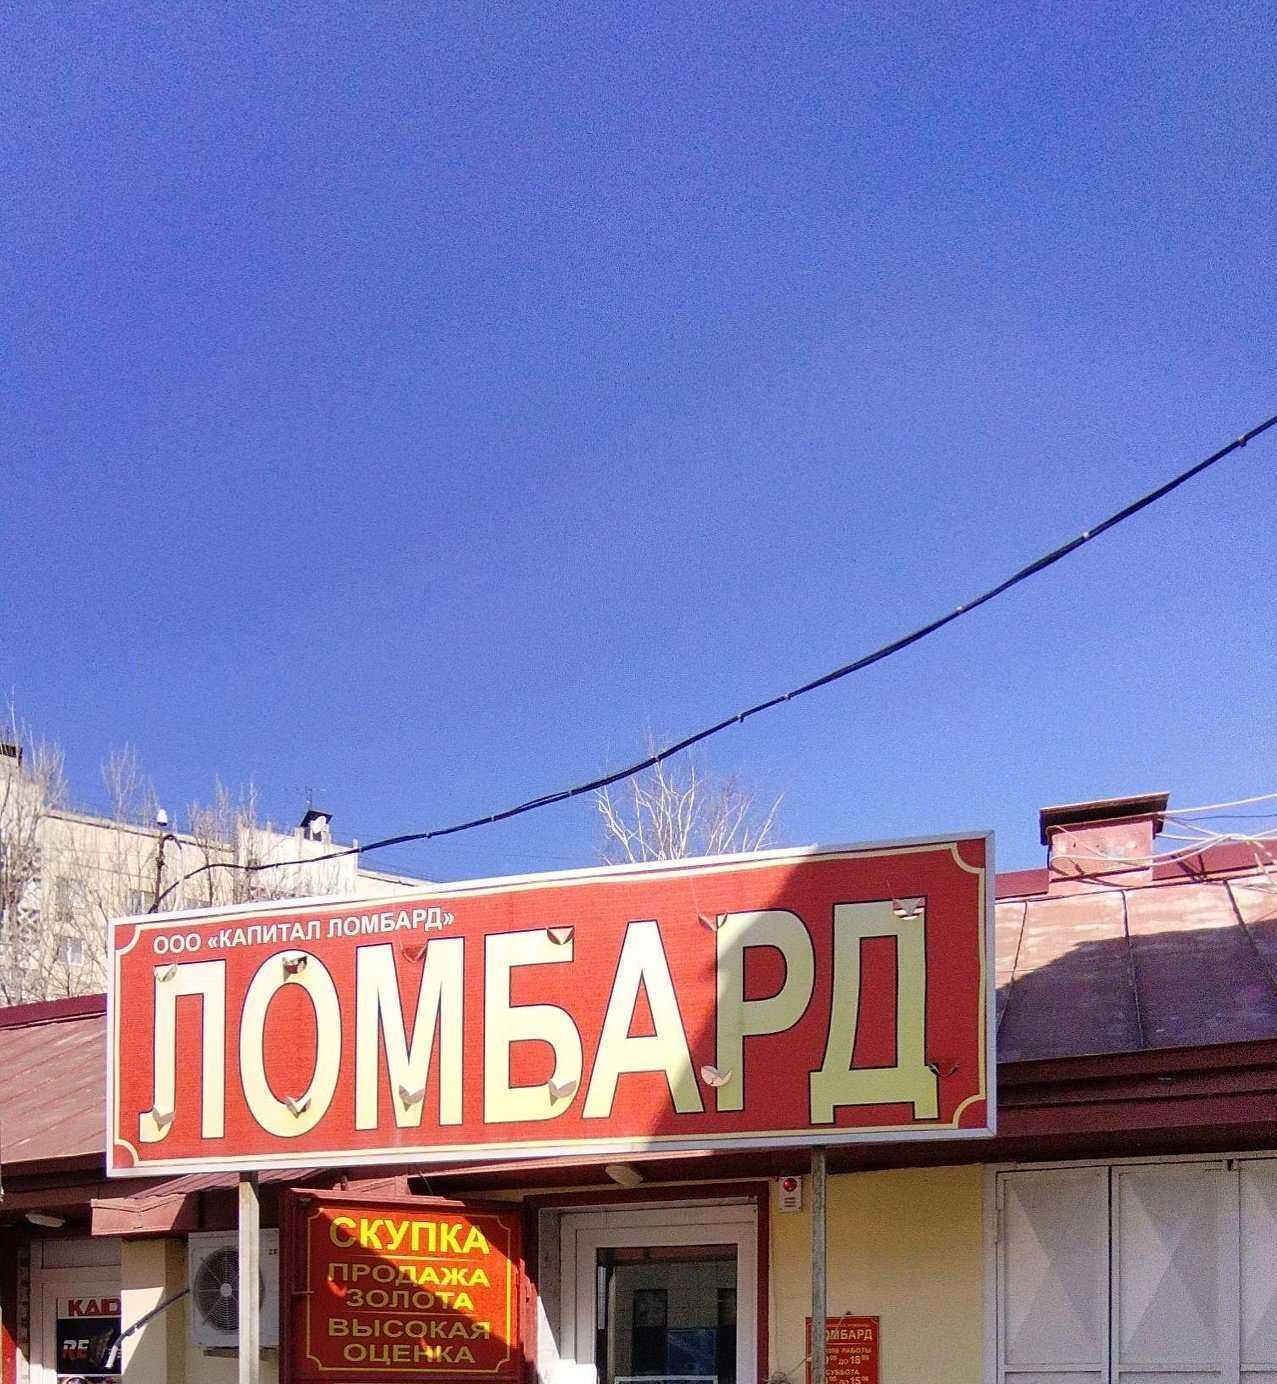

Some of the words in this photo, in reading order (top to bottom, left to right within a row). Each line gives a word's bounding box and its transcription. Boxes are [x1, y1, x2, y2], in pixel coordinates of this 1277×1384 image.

[152, 932, 202, 955] ООО
[208, 919, 321, 949] «КАПИТАЛ
[327, 906, 456, 938] ЛОМБАРД»
[138, 898, 941, 1144] ЛОМБАРД
[329, 1216, 491, 1254] СКУПКА
[328, 1263, 491, 1288] ПРОДАЖА
[346, 1289, 475, 1311] ЗОЛОТА
[328, 1318, 491, 1340] ВЫСОКАЯ
[343, 1344, 476, 1366] ОЦЕНКА
